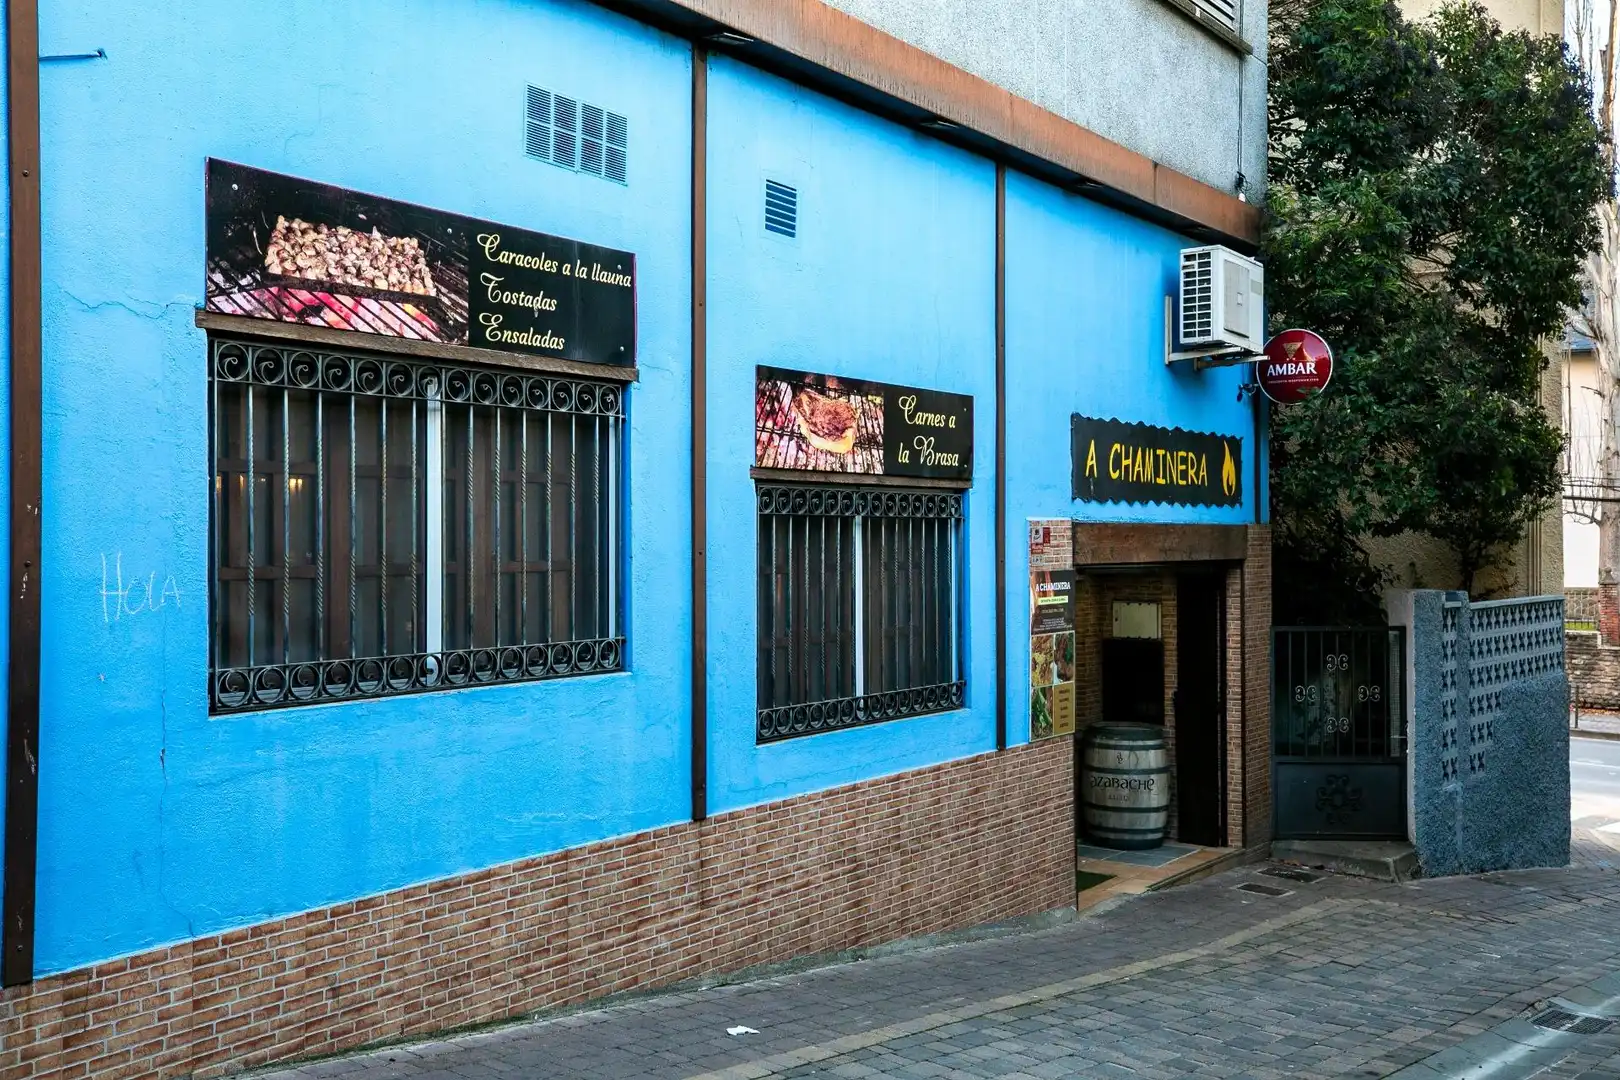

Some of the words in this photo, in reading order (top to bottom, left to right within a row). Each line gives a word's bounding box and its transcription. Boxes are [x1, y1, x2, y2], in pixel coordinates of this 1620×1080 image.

[477, 234, 559, 273] Caracoles
[562, 263, 571, 276] a
[575, 260, 588, 279] la
[591, 263, 632, 287] llauna
[480, 272, 558, 311] Tostadas
[479, 312, 565, 350] Ensaladas
[1267, 363, 1317, 376] AMBAR
[898, 395, 946, 427] Carnes
[948, 415, 956, 429] a
[898, 442, 910, 463] la
[913, 435, 959, 466] Brasa
[1085, 439, 1098, 478] A
[1109, 443, 1208, 487] CHAMINERA
